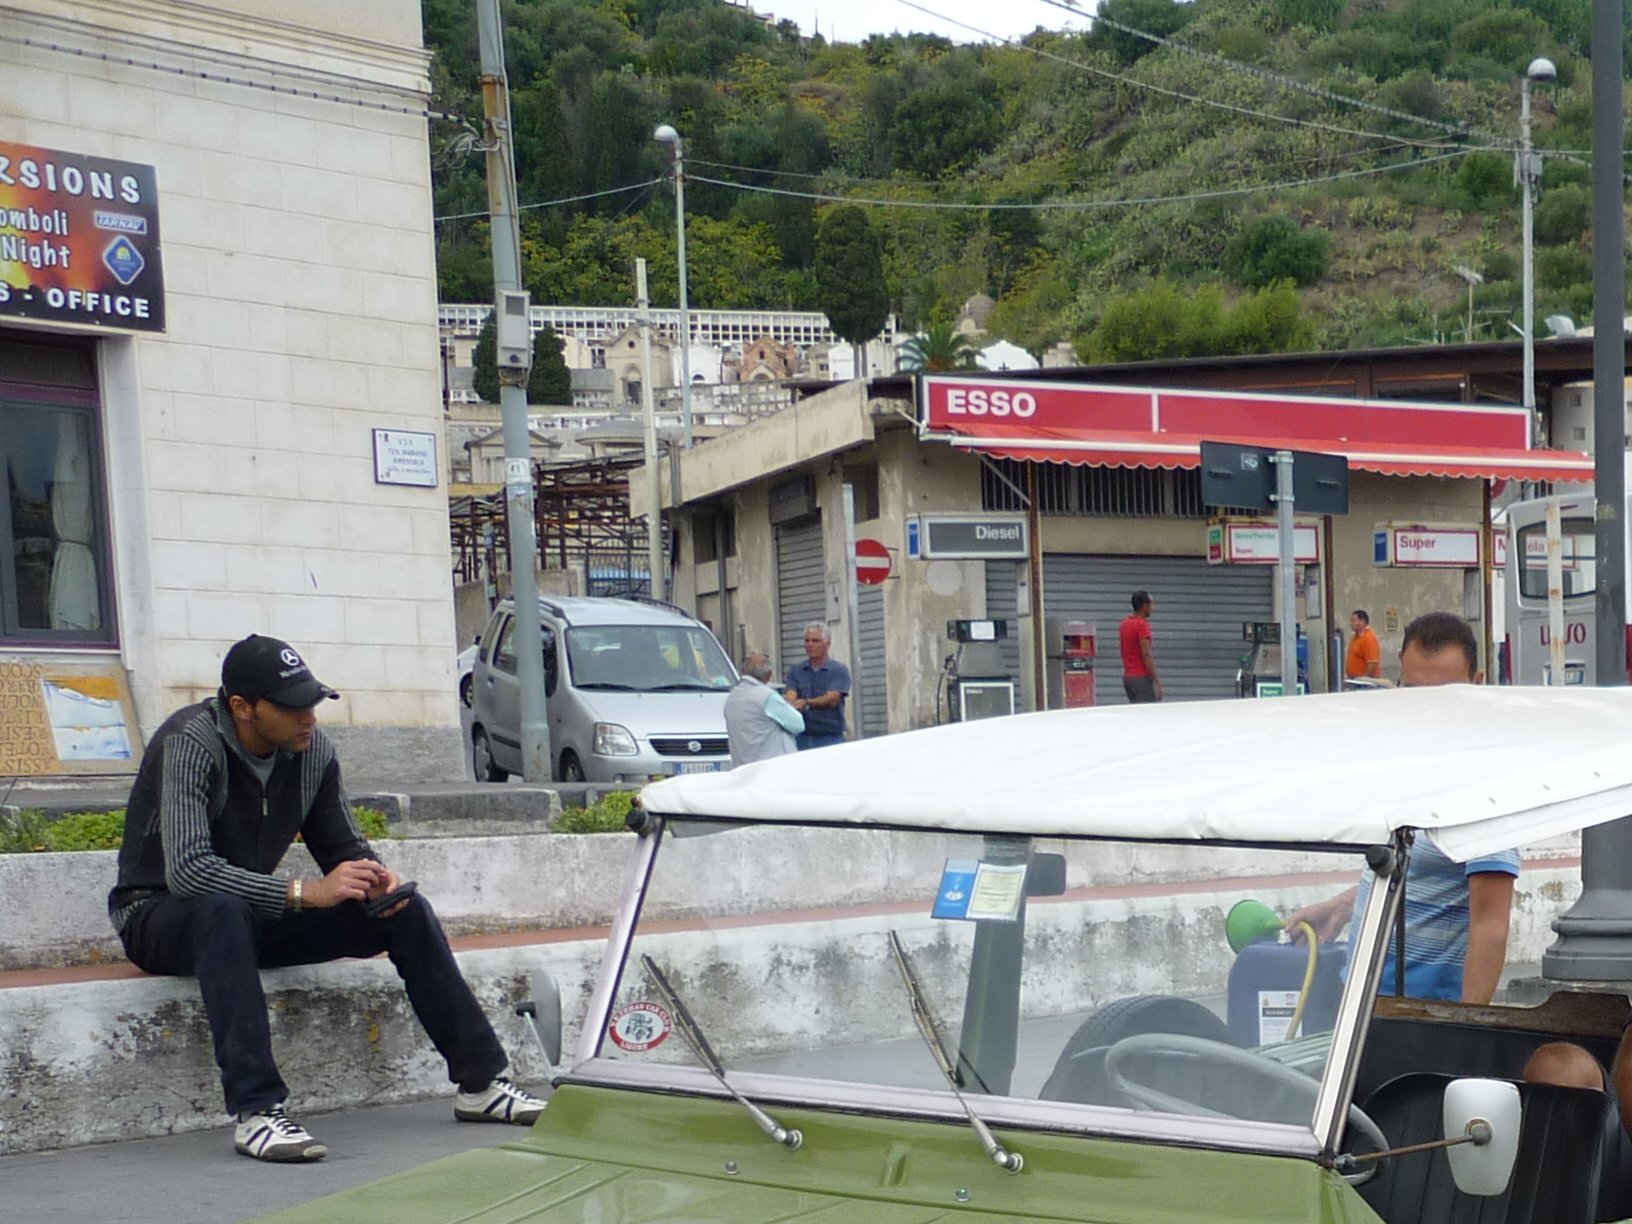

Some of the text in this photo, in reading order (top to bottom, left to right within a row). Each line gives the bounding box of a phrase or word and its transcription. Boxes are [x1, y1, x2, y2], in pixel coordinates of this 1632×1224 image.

[2, 236, 70, 268] Night
[47, 288, 150, 318] OFFICE
[947, 389, 1036, 418] ESSO
[975, 525, 1020, 540] Diesel
[1400, 536, 1436, 551] Super
